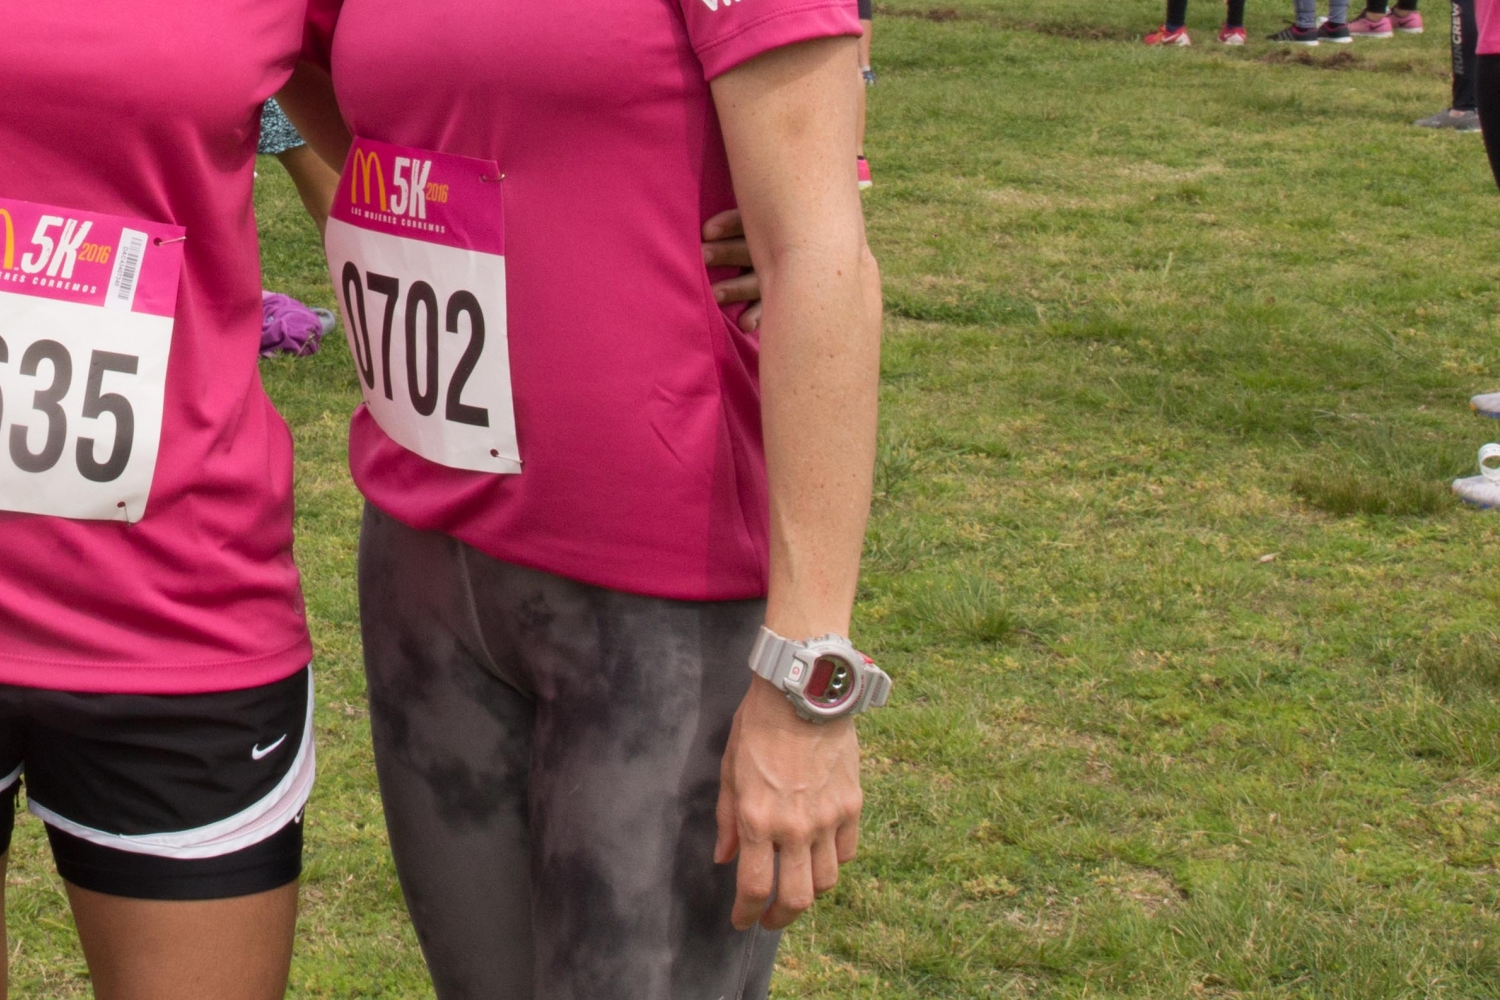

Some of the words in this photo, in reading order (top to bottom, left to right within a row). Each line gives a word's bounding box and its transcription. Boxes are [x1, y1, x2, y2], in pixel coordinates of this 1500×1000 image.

[390, 157, 432, 219] 5K
[426, 182, 449, 203] 2016
[20, 214, 93, 278] 5K
[78, 242, 112, 264] 2016
[351, 207, 361, 216] LAS
[364, 210, 397, 225] MUJERES
[401, 218, 445, 233] CORREMOS
[32, 277, 97, 294] CORREMOS
[342, 261, 490, 428] 0702
